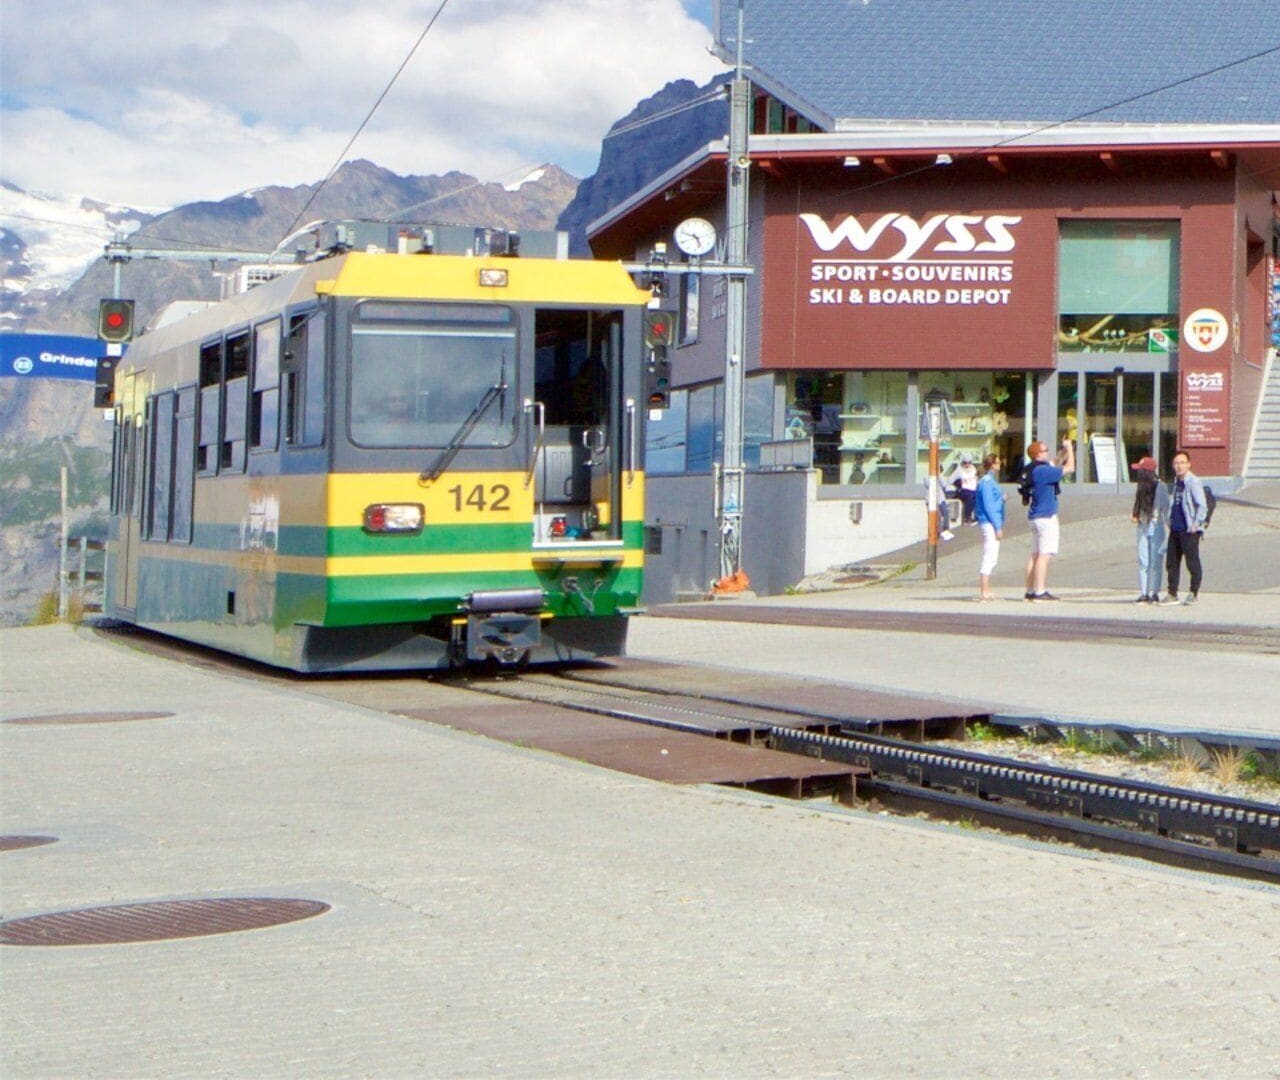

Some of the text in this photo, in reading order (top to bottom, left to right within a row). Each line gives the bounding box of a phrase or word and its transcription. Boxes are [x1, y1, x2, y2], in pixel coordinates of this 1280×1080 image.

[811, 265, 1013, 281] SPORT SOUVENIRS
[810, 288, 1011, 304] SKI & BOARD DEPOT
[448, 484, 511, 512] 142
